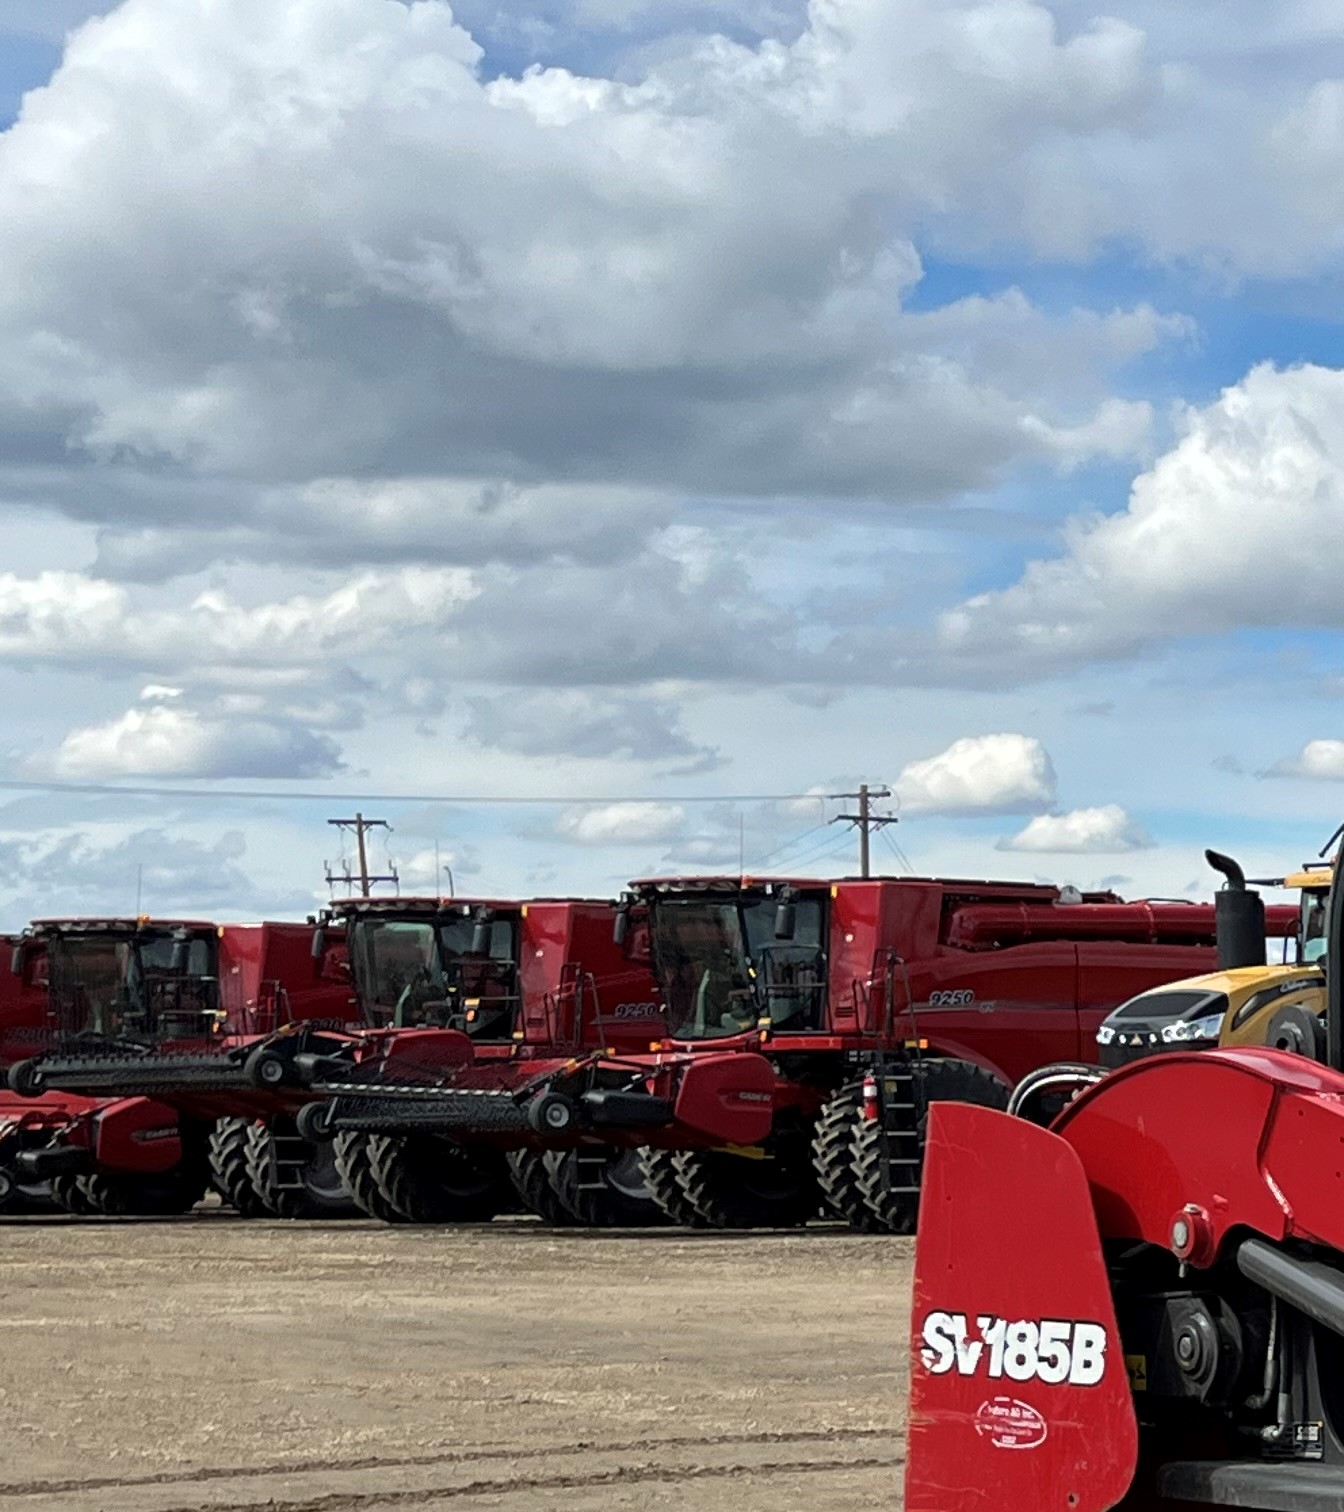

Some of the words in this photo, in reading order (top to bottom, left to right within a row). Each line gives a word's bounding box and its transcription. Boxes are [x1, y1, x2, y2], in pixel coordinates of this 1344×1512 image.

[929, 989, 975, 1007] 9250
[615, 1003, 657, 1018] 9250
[920, 1309, 1108, 1387] SV185B
